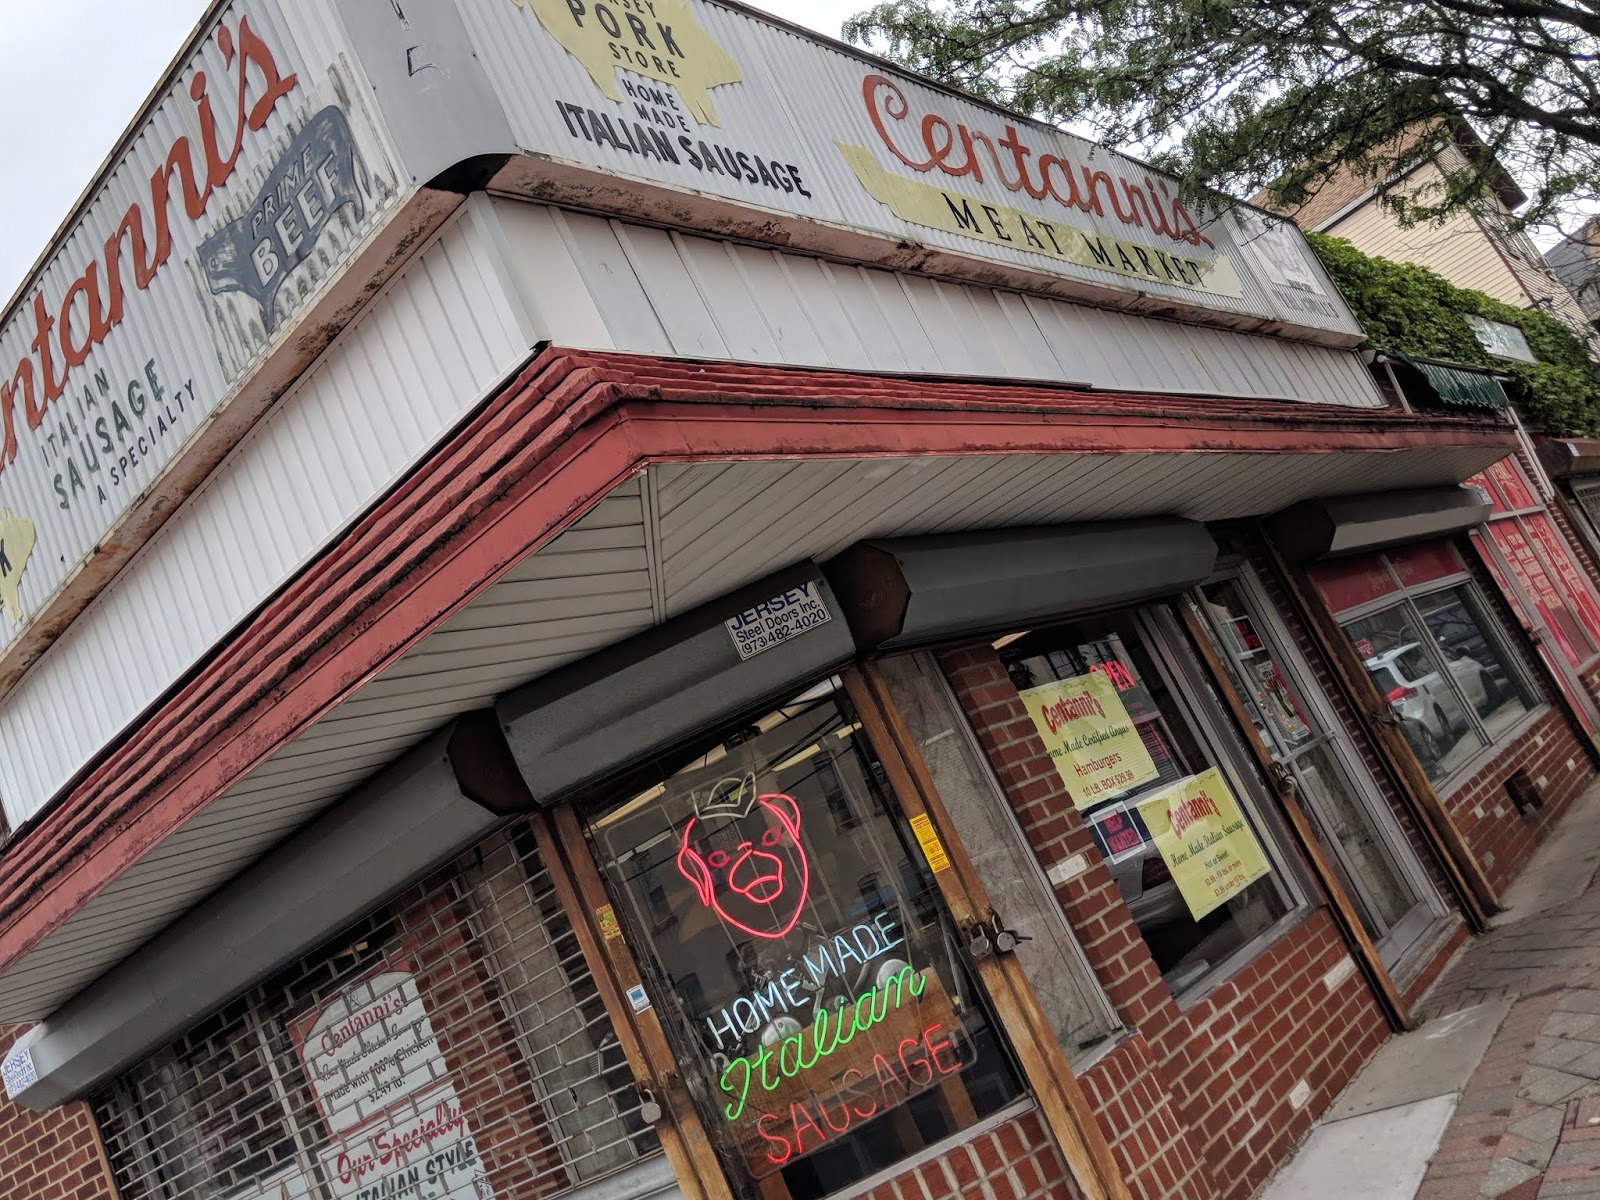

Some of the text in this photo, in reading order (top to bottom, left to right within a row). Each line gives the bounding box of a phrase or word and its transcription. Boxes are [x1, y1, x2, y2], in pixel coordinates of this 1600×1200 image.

[567, 0, 685, 59] PORK
[608, 41, 681, 78] STORE
[622, 78, 679, 111] HOME
[633, 101, 691, 133] MADE
[556, 100, 812, 198] ITALIAN SAUSAGE
[862, 74, 1215, 250] Centanni's
[250, 150, 338, 288] BEEF
[251, 142, 312, 240] PRIME
[0, 14, 297, 473] ntanni's
[941, 192, 1207, 288] MEAT MARKET
[41, 368, 110, 467] ITALIAN
[53, 358, 166, 510] SAUSAGE
[96, 379, 196, 505] A SPECIALTY
[731, 582, 811, 630] JERSEY
[736, 599, 820, 643] Steel Doors Inc.
[1041, 690, 1107, 735] Centanni's
[1063, 738, 1083, 754] Made
[1082, 730, 1110, 747] Certified
[1108, 725, 1130, 739] Angus
[1073, 752, 1123, 777] Hamburgers
[1082, 786, 1091, 798] 10
[1100, 776, 1117, 790] BOX
[1166, 790, 1222, 840] Centanni's
[1170, 819, 1245, 868] Home Made Italian Sausage
[719, 965, 927, 1121] Italian
[351, 1070, 370, 1089] with
[757, 1022, 963, 1165] SAUSAGE
[337, 1103, 464, 1185] Our Specialty
